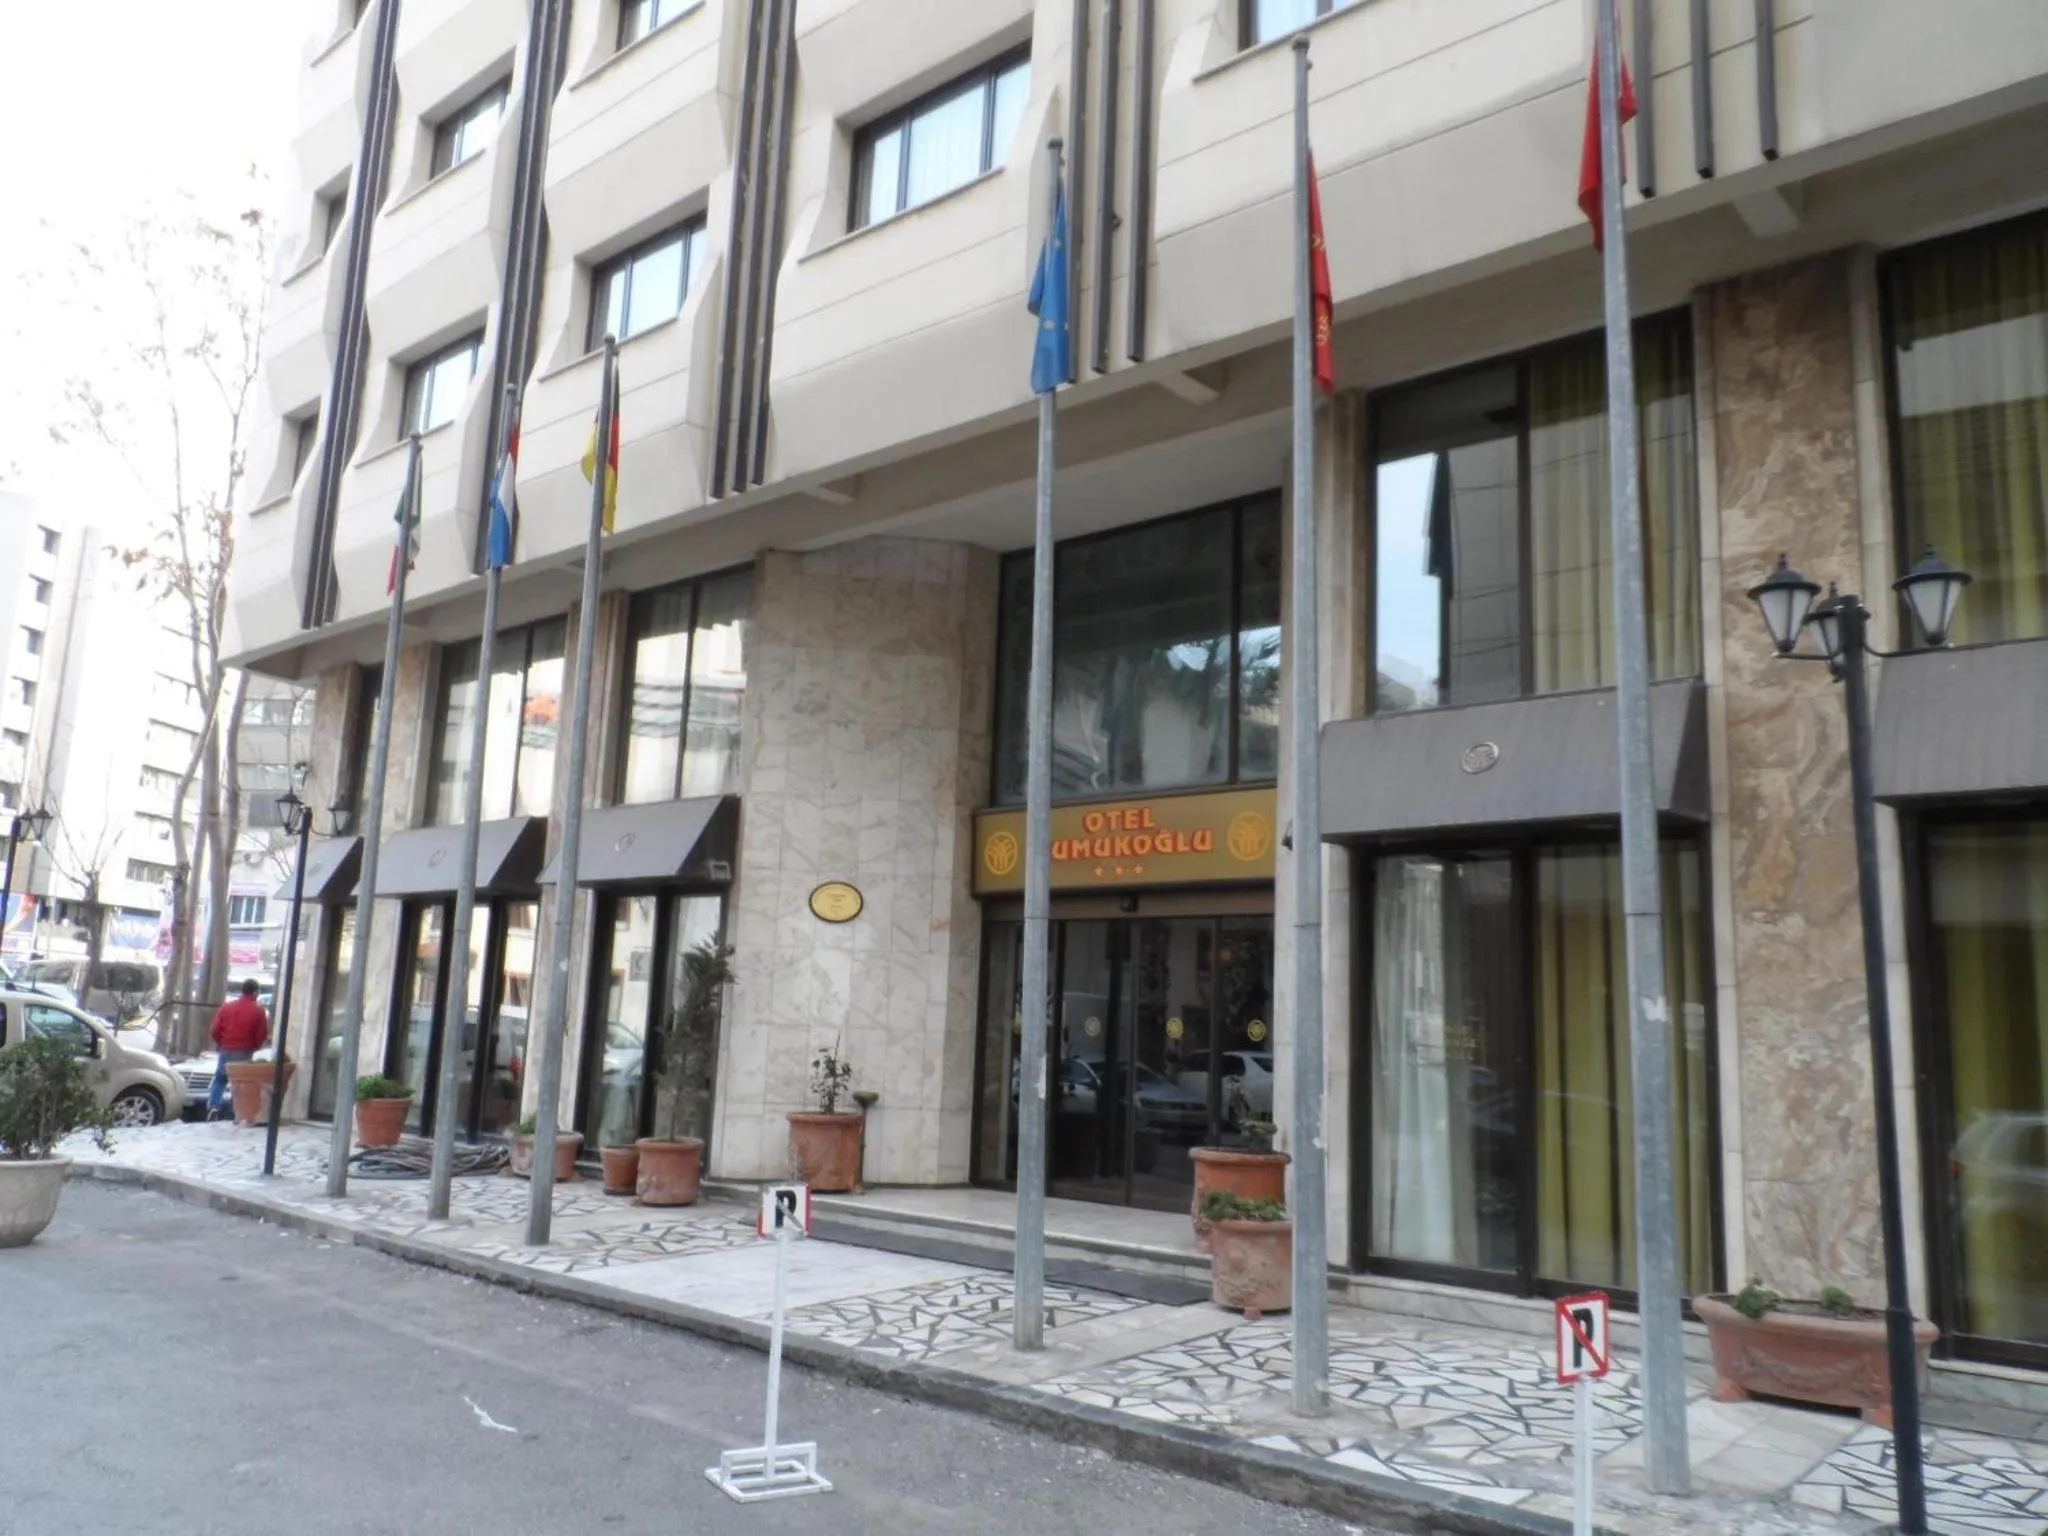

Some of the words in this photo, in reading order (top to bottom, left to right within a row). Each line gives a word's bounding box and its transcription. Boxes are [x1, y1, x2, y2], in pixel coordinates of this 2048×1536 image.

[1083, 806, 1157, 833] OTEL
[1051, 827, 1214, 862] UMUKOĞLU
[775, 1190, 797, 1229] P
[1571, 1308, 1594, 1369] P
